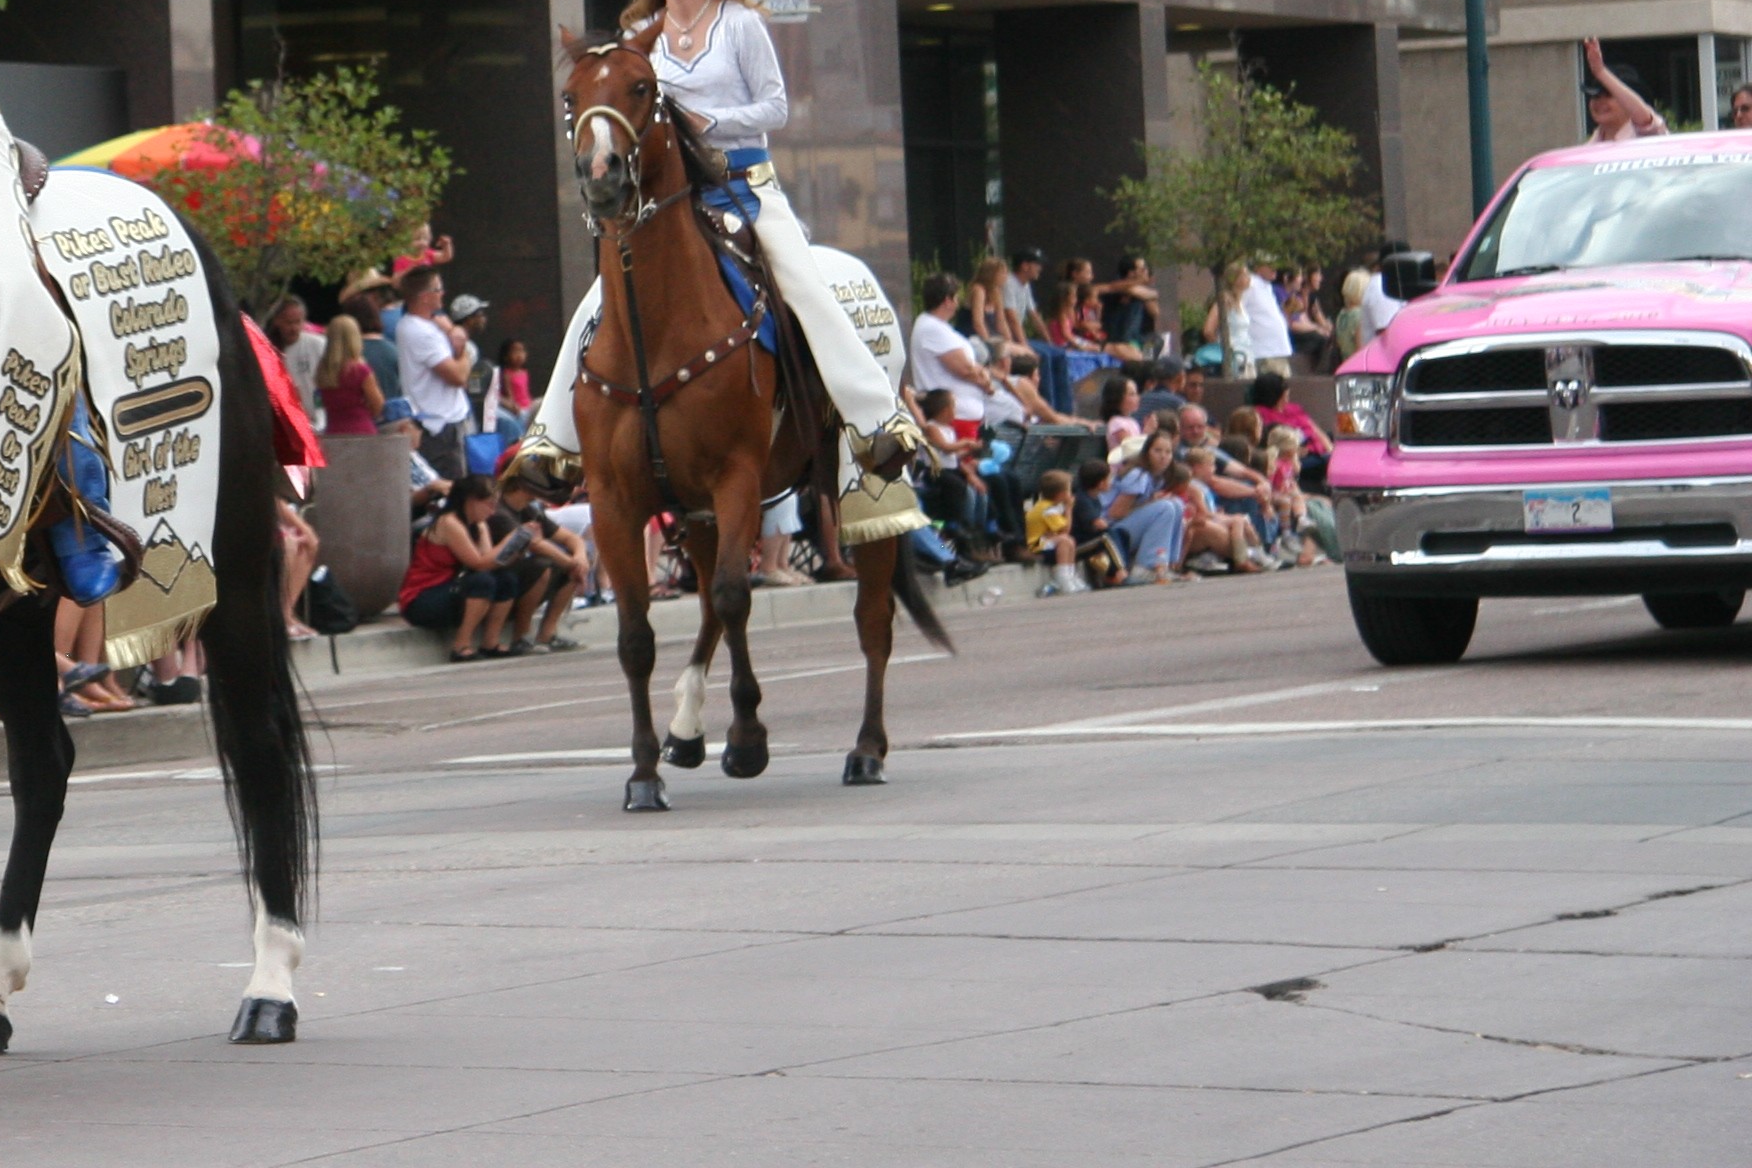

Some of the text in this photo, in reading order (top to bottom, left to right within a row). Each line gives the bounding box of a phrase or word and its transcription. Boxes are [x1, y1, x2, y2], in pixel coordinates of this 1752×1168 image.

[52, 208, 168, 261] Pikes Peak
[70, 245, 196, 300] or Bust Rodeo
[109, 288, 189, 338] Colorado
[1, 348, 52, 399] Pikes
[125, 336, 187, 389] Springs
[123, 428, 201, 481] Girl of the
[143, 476, 178, 518] West
